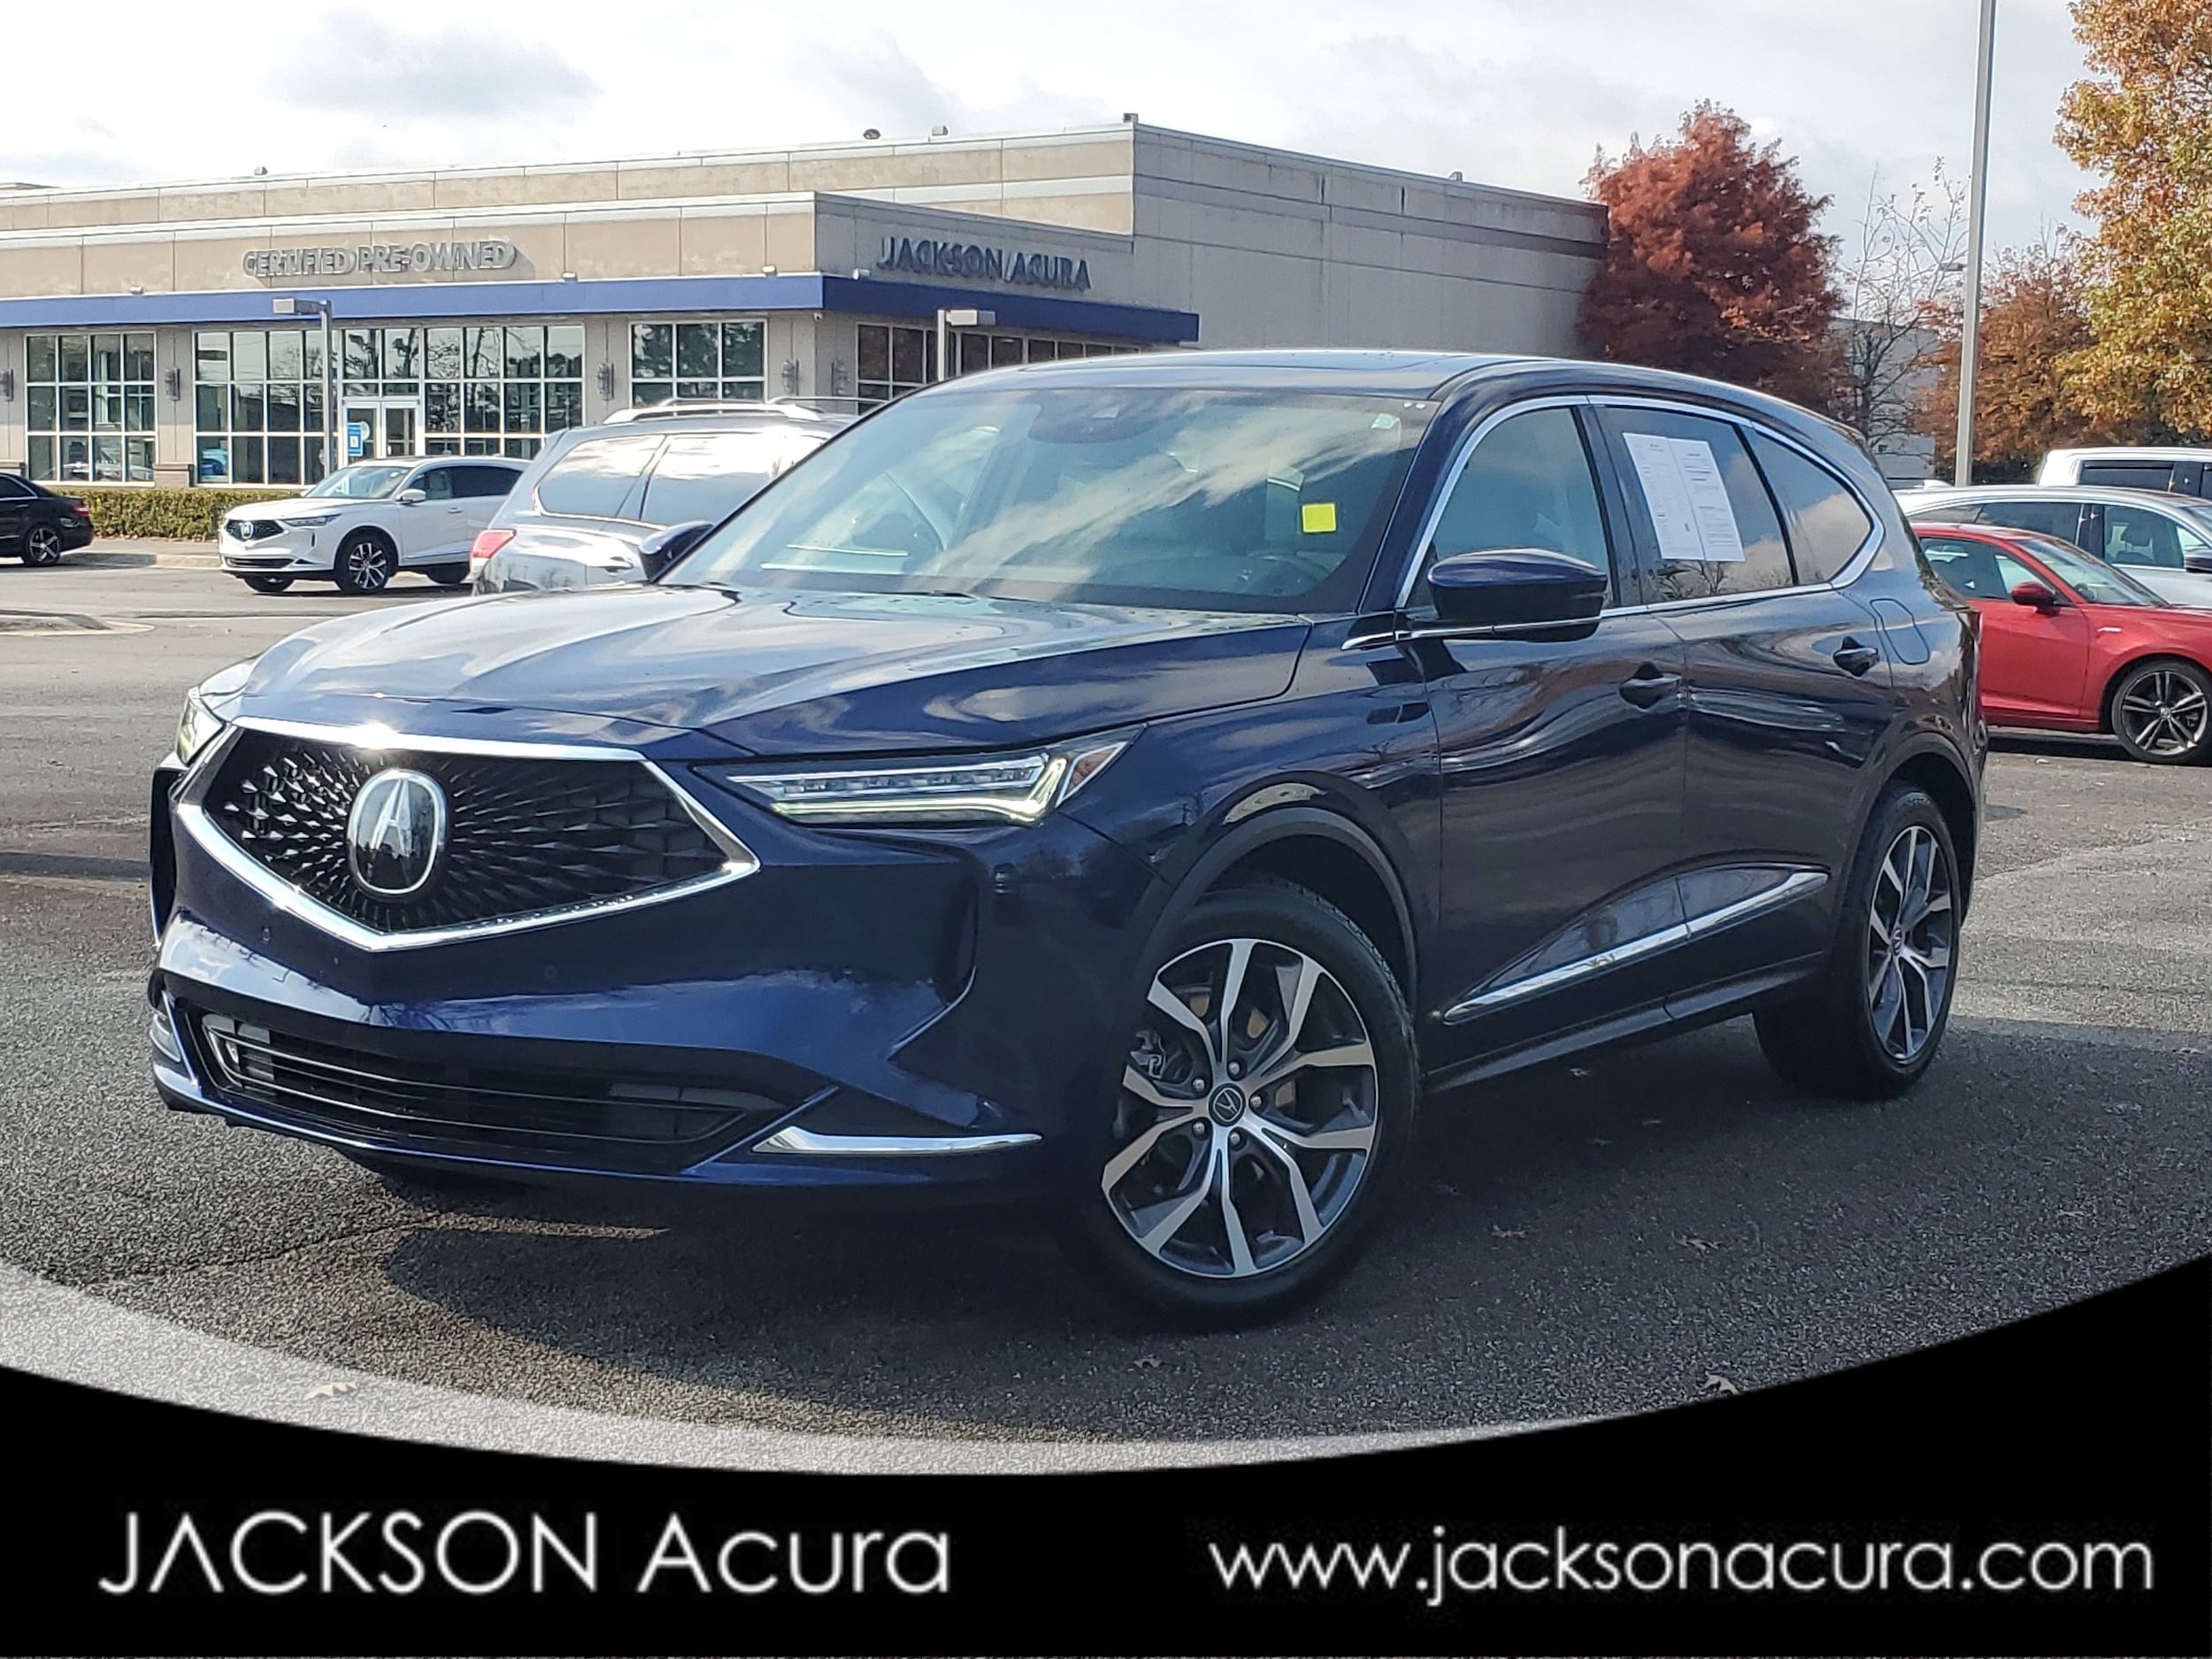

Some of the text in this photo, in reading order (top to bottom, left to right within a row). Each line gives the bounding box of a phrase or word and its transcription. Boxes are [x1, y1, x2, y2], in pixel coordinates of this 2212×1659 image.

[242, 239, 517, 277] CERTIFIED PRE-OWNED
[877, 236, 1092, 292] JACKSON ACURA
